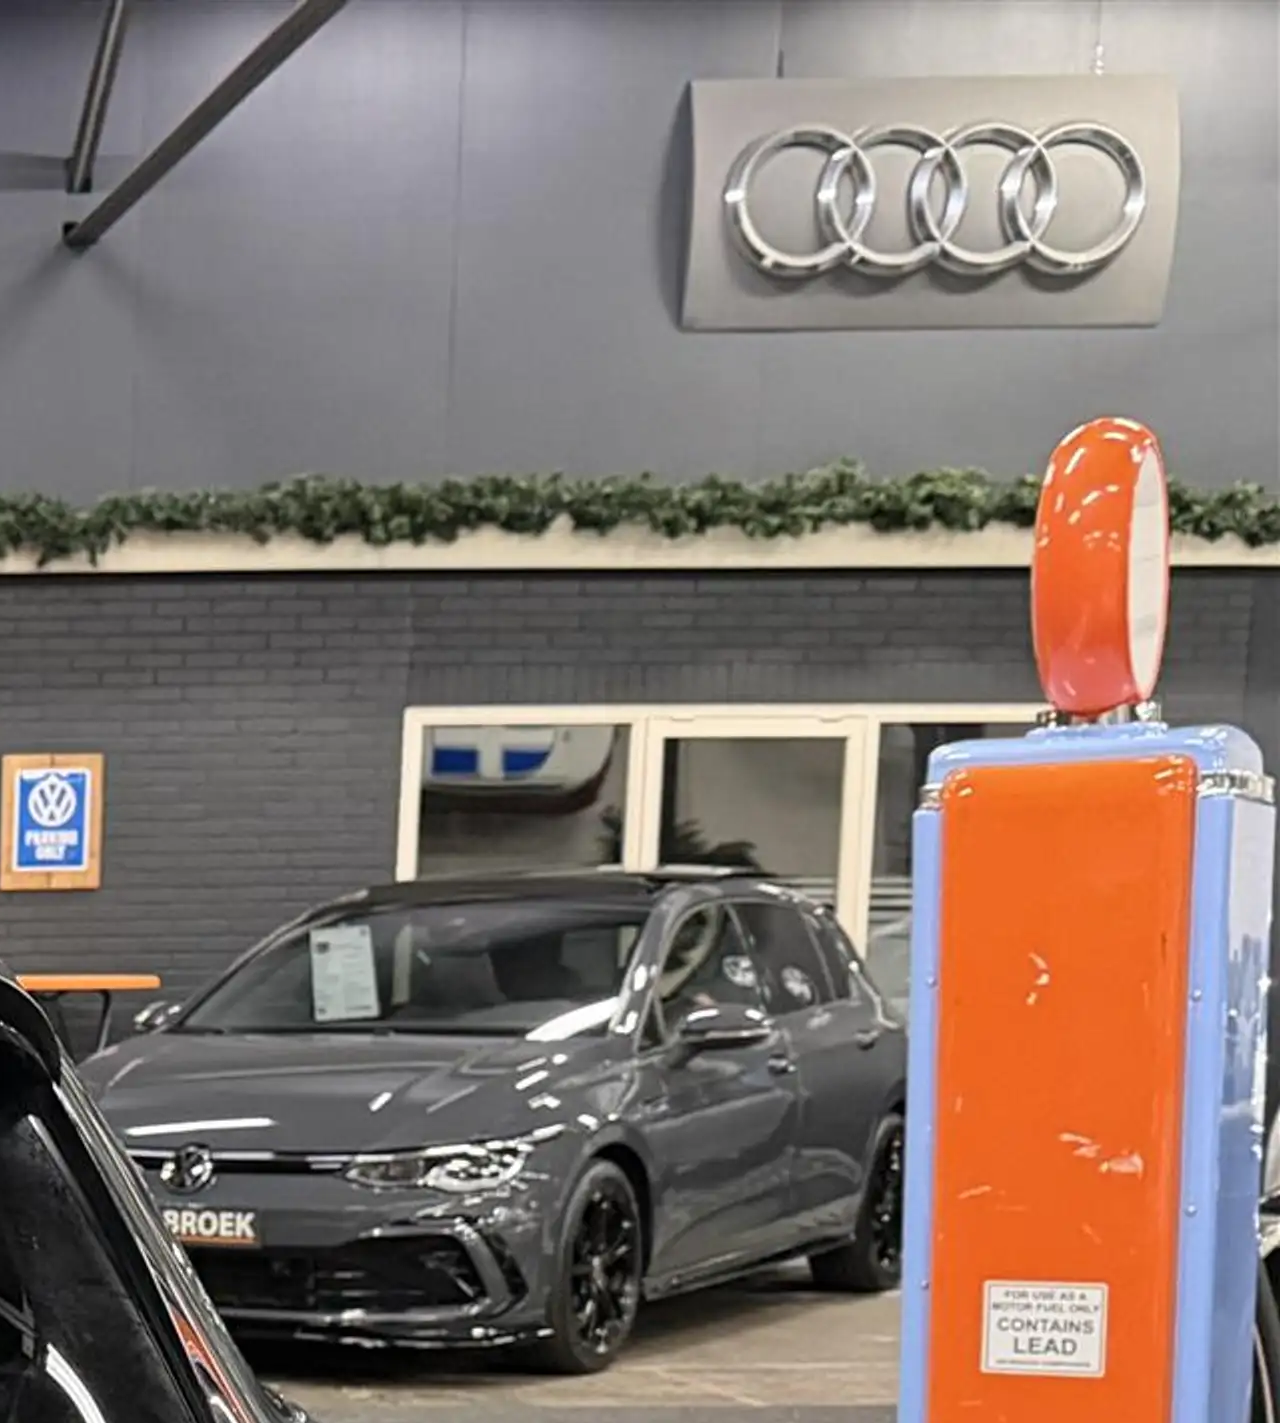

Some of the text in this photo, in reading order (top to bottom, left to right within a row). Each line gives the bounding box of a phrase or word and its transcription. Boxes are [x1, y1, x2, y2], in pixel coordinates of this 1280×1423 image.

[1004, 1290, 1028, 1300] FOR
[1060, 1292, 1075, 1301] AS
[992, 1302, 1099, 1314] MOTOR FUEL ONLY
[996, 1317, 1095, 1334] CONTAINS
[1013, 1337, 1078, 1356] LEAD
